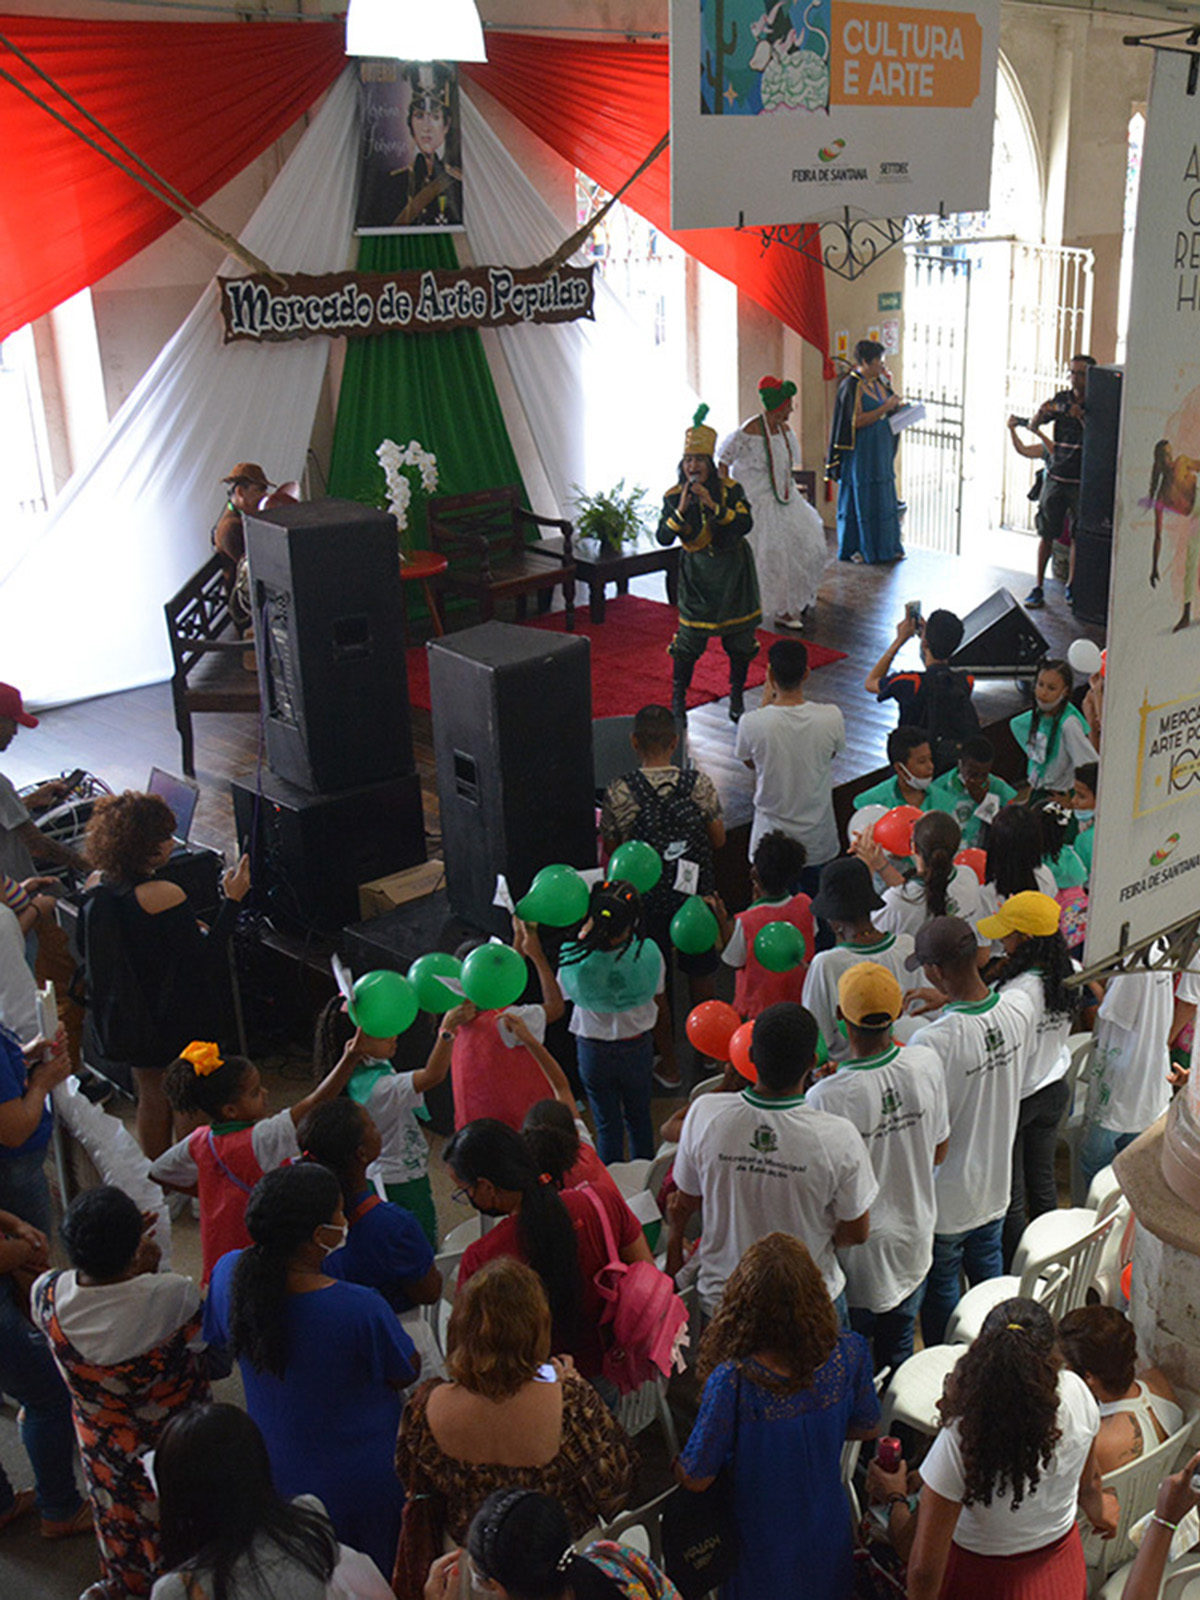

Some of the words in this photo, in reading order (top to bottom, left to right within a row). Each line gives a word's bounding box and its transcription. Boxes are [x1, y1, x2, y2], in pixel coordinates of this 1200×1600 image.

[843, 19, 965, 60] CULTURA
[843, 59, 860, 95] E
[868, 61, 935, 97] ARTE
[792, 169, 817, 183] FEIRA
[818, 169, 830, 182] DE
[831, 168, 869, 182] SANTANA
[226, 280, 374, 336] Mercado
[376, 282, 413, 325] de
[415, 271, 488, 322] Arte
[488, 268, 590, 319] Popular
[1149, 730, 1183, 758] ARTE
[1119, 879, 1146, 902] FEIRA
[1147, 872, 1161, 889] DE
[1161, 854, 1200, 882] SANTANA
